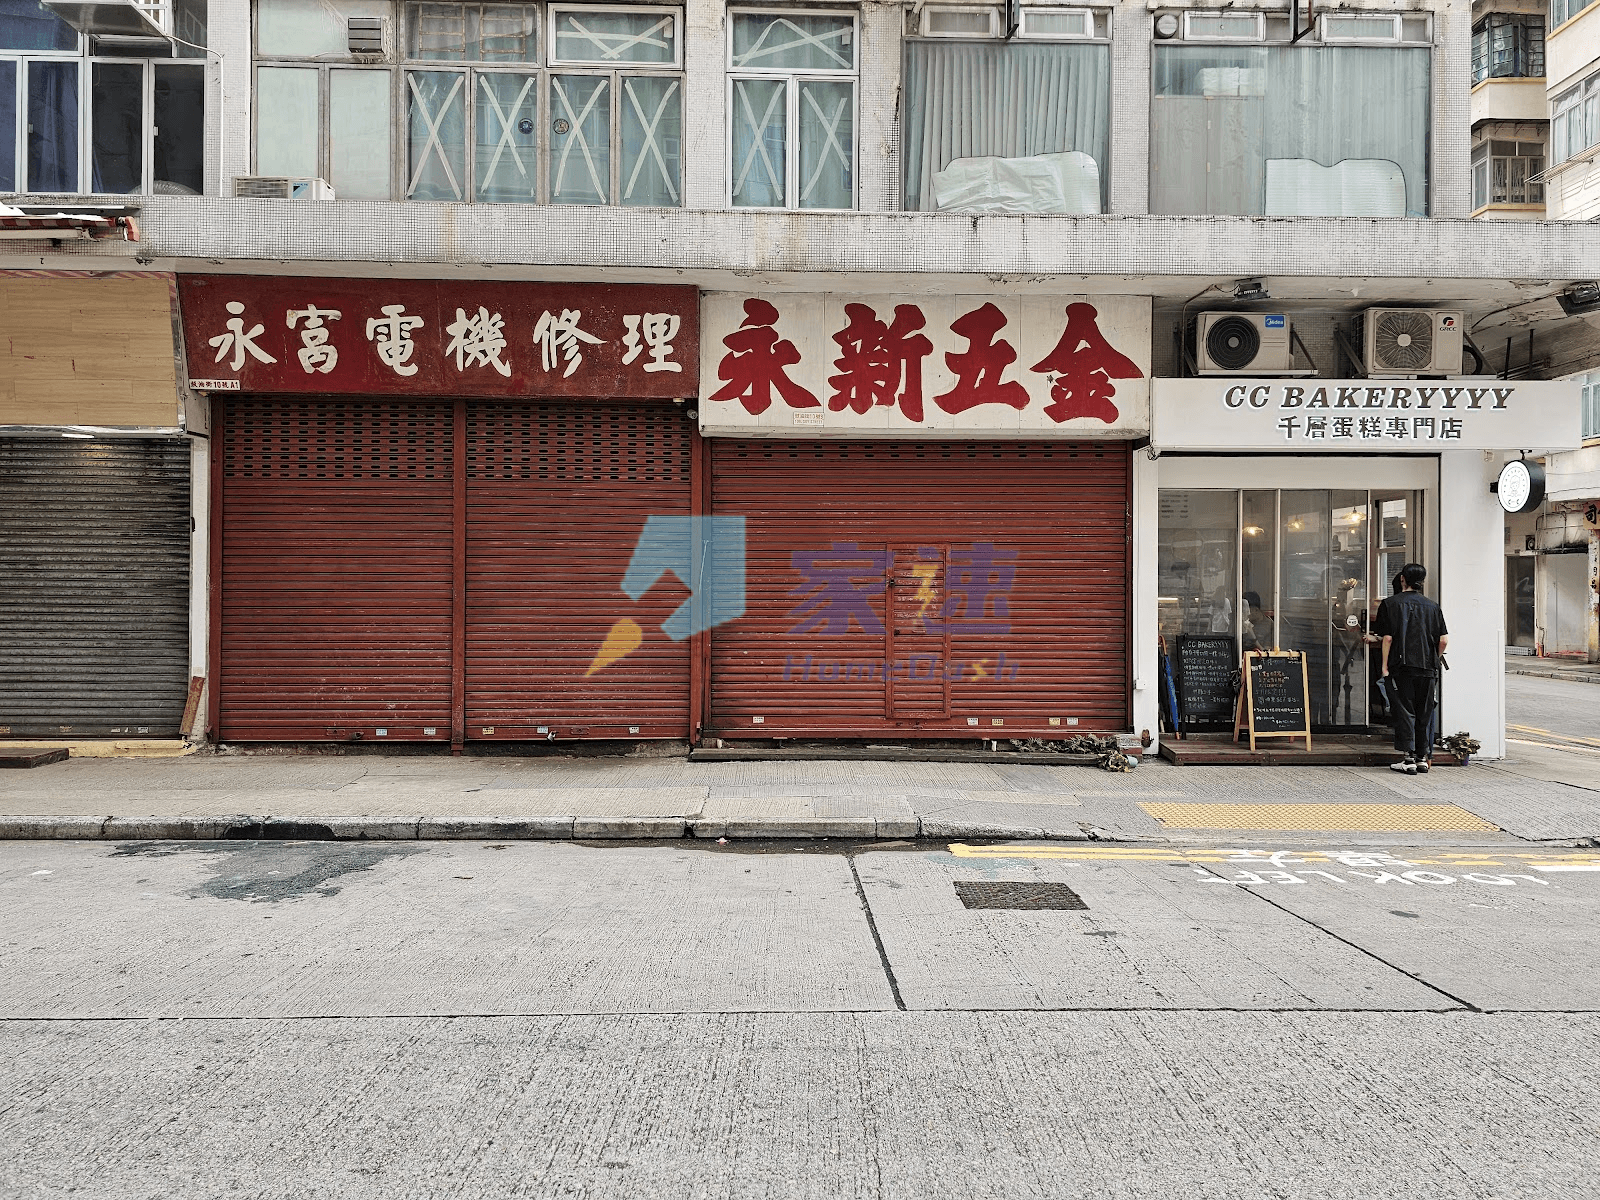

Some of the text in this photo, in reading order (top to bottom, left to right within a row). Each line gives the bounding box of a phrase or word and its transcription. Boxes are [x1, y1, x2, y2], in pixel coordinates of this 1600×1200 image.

[208, 301, 683, 378] 永富電機修理
[708, 297, 1144, 424] 永新五金
[1225, 385, 1514, 409] CC BAKERYYYY
[1278, 415, 1464, 440] 千層蛋糕專門店
[1584, 504, 1600, 525] 司
[1348, 870, 1552, 889] LOOK
